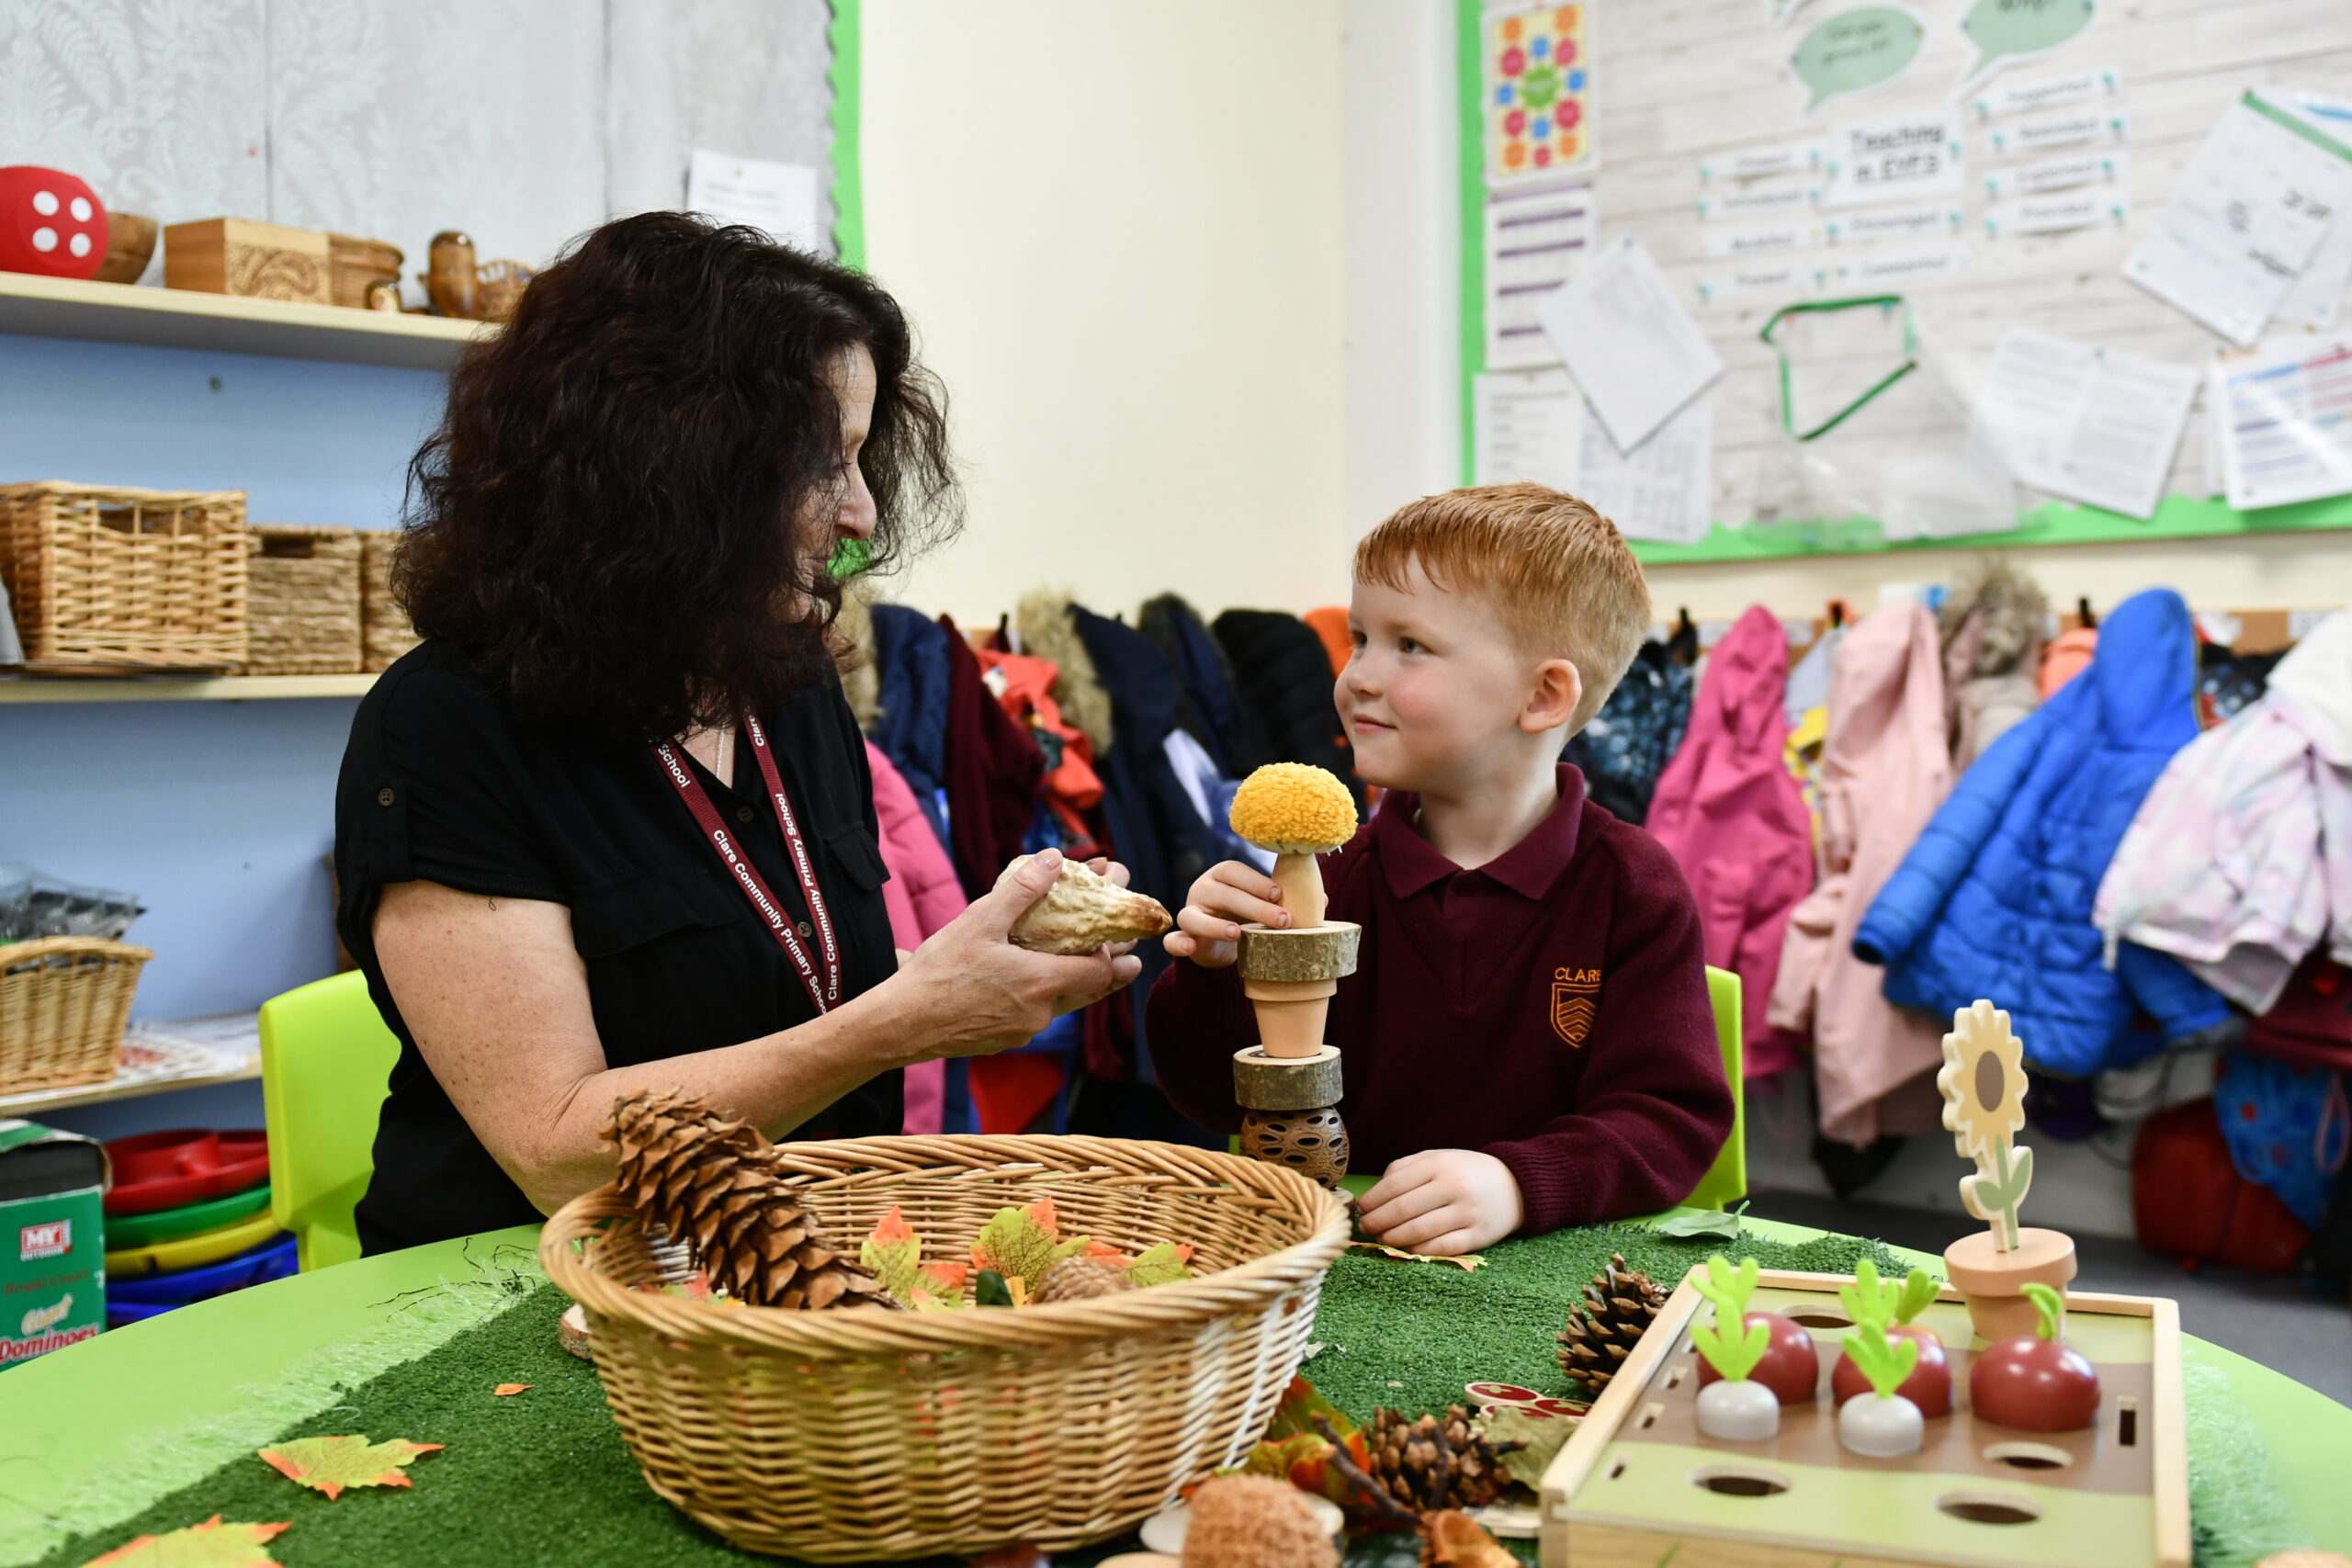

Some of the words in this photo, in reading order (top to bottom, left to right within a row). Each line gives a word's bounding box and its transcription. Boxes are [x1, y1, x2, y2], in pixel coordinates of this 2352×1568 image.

[1849, 124, 1945, 152] Teaching
[748, 715, 764, 747] Clare
[657, 743, 691, 788] School
[775, 794, 797, 836] School
[793, 839, 814, 887] Primary
[714, 829, 737, 863] Clare
[734, 863, 784, 930] Community
[781, 928, 812, 976] Primary
[808, 976, 827, 1015] Schoo
[809, 889, 836, 962] Community
[828, 966, 838, 1000] Clare
[22, 1293, 74, 1336] Giant
[0, 1323, 99, 1365] Dominoes
